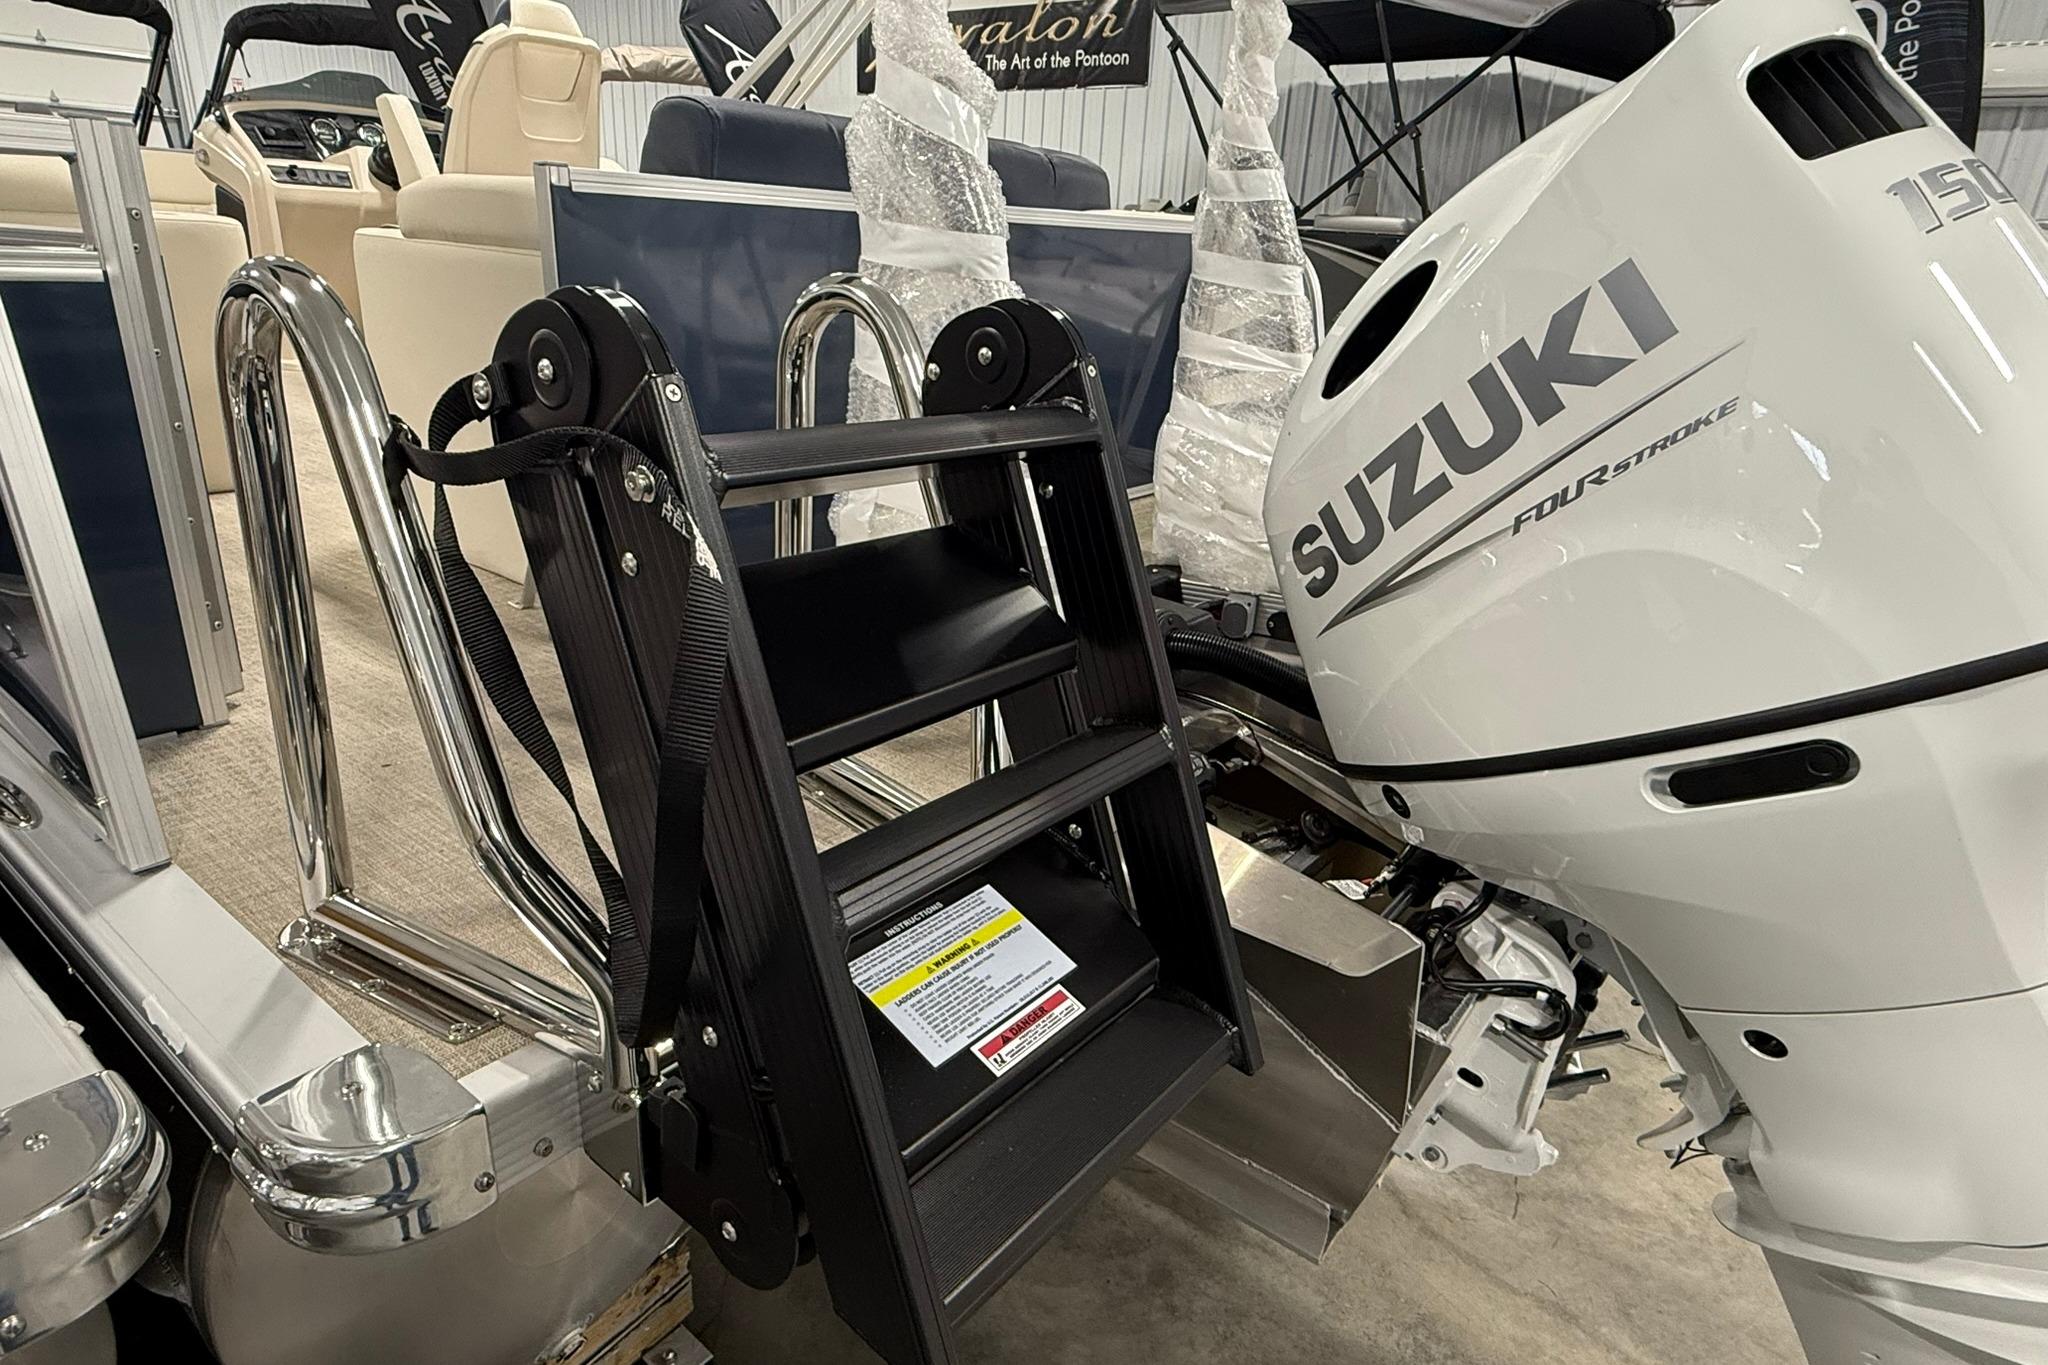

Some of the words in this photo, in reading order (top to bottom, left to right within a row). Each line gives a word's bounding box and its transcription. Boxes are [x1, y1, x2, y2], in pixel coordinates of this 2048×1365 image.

[953, 0, 1126, 46] valon
[985, 54, 1007, 71] The
[1010, 52, 1031, 71] Art
[1034, 51, 1048, 69] of
[1050, 50, 1071, 68] the
[1075, 49, 1129, 67] Pontoon
[1896, 40, 1919, 81] the
[418, 61, 449, 101] LUXURY
[1885, 158, 2017, 234] 150
[1292, 257, 1679, 598] SUZUKI
[883, 900, 944, 937] INSTRUCTIONS
[894, 987, 922, 1007] LADDERS
[919, 979, 935, 991] CAN
[932, 969, 952, 983] CAUSE
[973, 946, 987, 957] NOT
[984, 938, 1000, 950] USED
[931, 942, 972, 969] WARNING
[1007, 1005, 1048, 1036] DANGER
